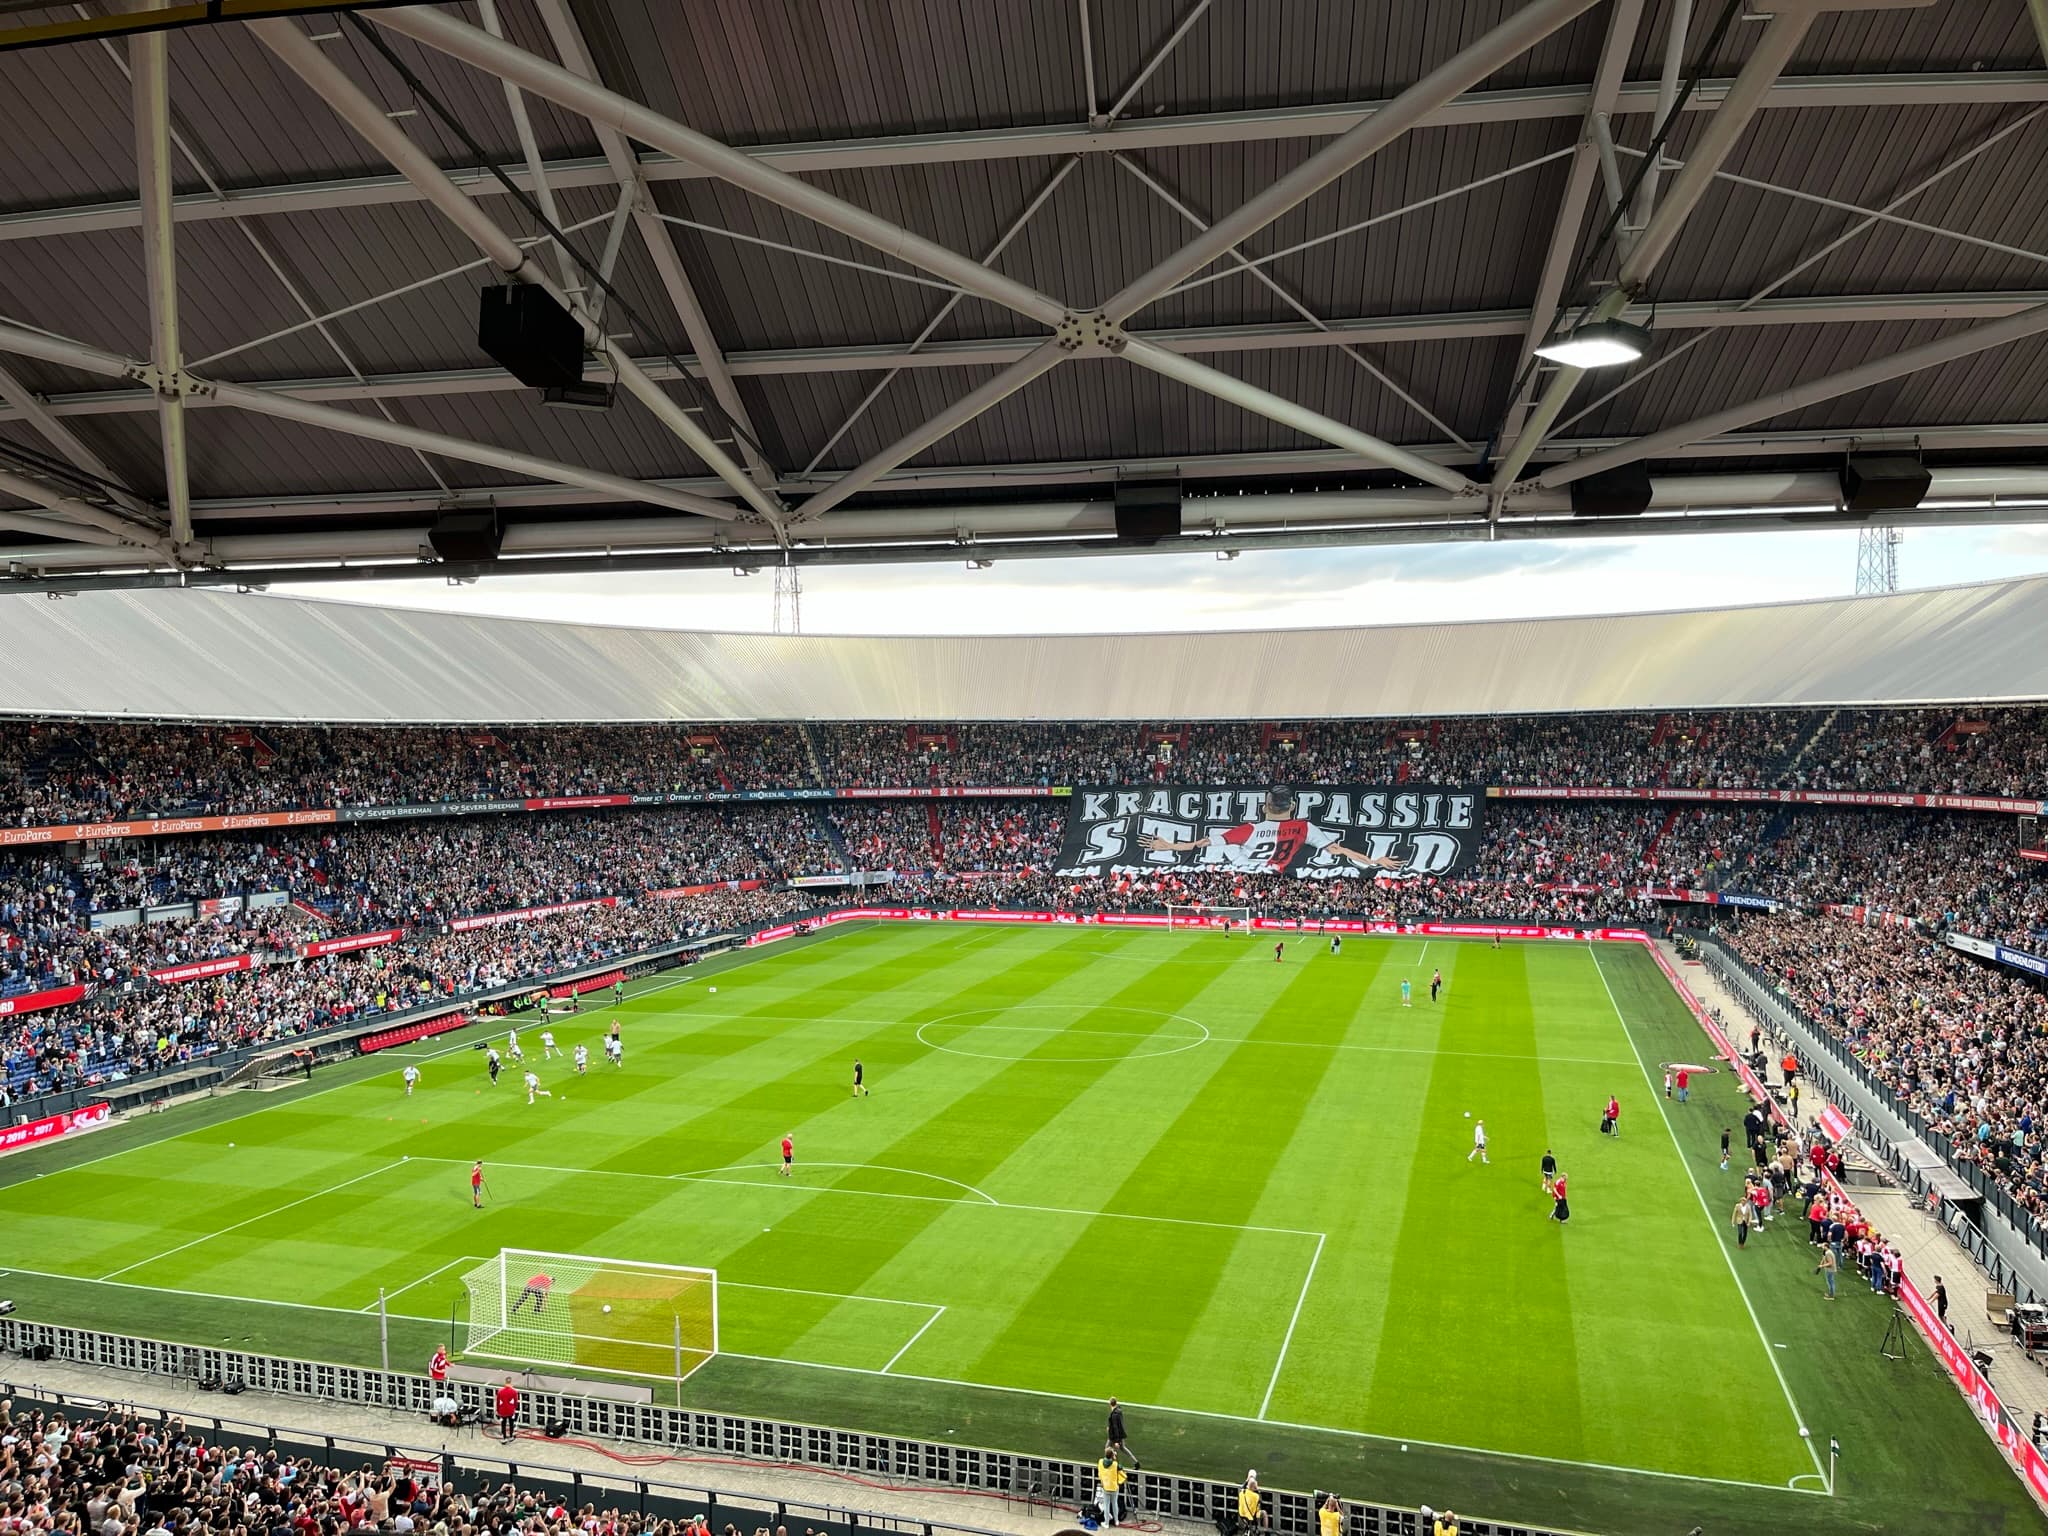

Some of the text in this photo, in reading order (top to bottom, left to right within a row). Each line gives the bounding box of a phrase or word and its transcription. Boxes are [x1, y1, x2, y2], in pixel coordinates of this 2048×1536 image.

[632, 795, 653, 803] Ormer
[669, 793, 692, 801] Ormer
[709, 792, 731, 800] Ormer
[367, 807, 432, 818] SEVERS BREEMAN
[461, 802, 520, 812] SEVERS BREEMAN
[1080, 790, 1268, 823] KRACHT
[1295, 791, 1474, 829] PASSIE
[231, 816, 269, 827] EuroParcs
[295, 812, 331, 822] EuroParcs
[86, 825, 131, 837] EuroParcs
[161, 820, 203, 832] EuroParcs
[4, 830, 52, 843] EuroParcs
[1248, 839, 1295, 862] 28
[1296, 865, 1361, 880] VOOR
[0, 1001, 14, 1013] RD
[34, 1122, 54, 1136] 2017
